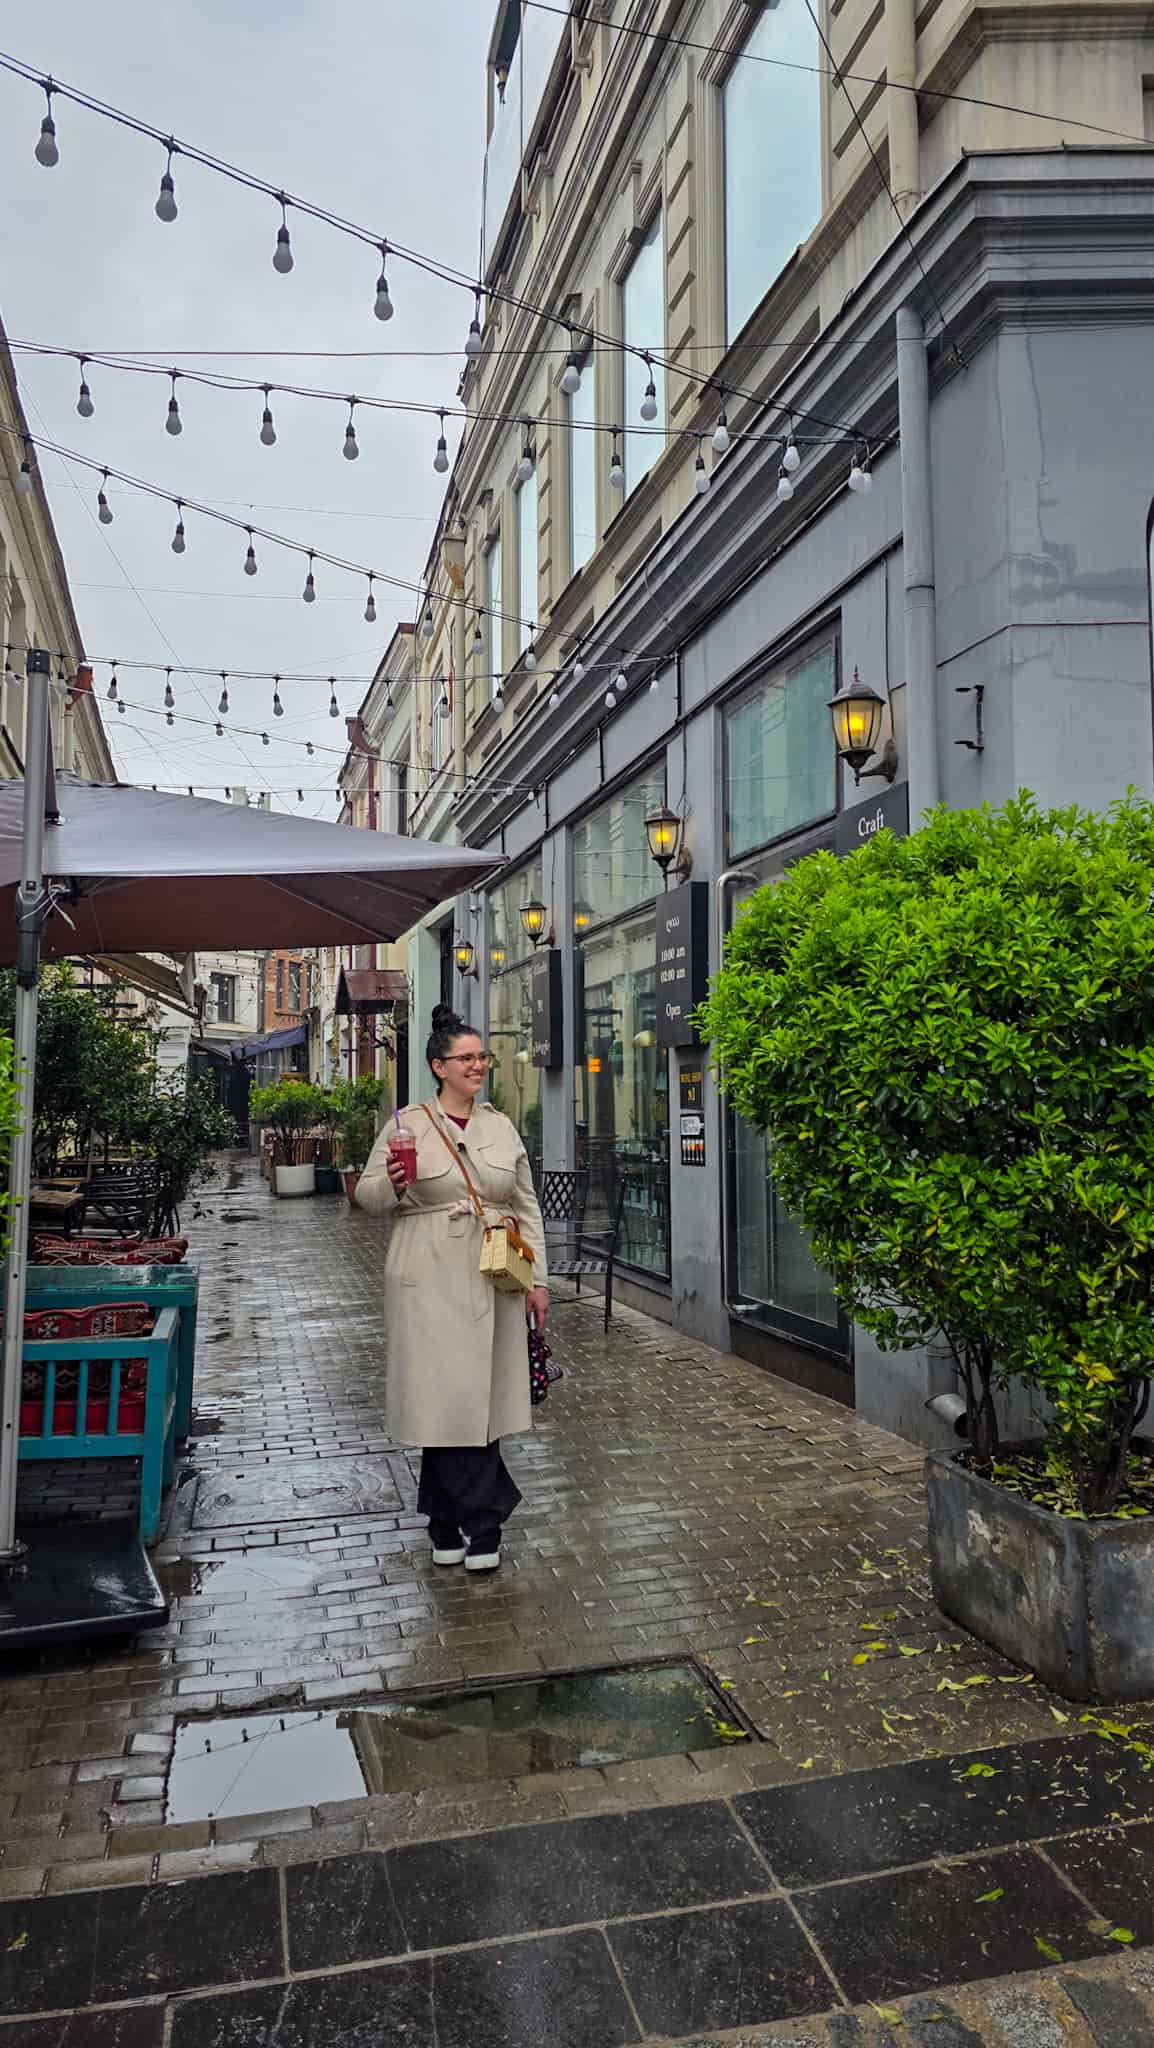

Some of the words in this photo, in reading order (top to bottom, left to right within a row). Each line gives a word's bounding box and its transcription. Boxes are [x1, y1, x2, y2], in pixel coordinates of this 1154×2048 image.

[858, 807, 884, 836] Craft
[661, 947, 675, 963] 10:00
[676, 946, 686, 958] am
[676, 967, 686, 979] am
[665, 1003, 681, 1021] Open
